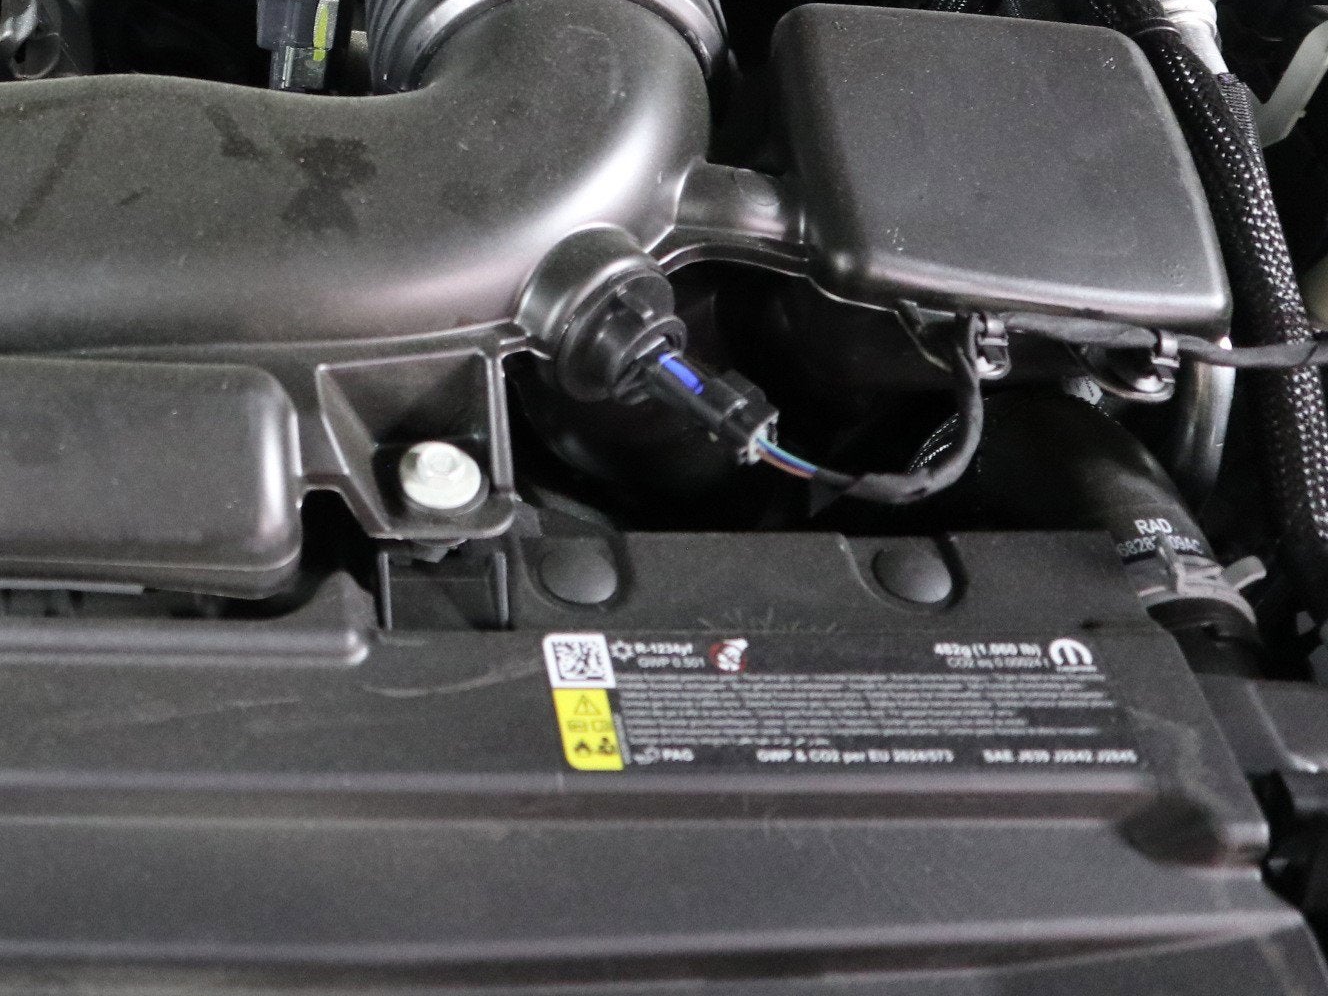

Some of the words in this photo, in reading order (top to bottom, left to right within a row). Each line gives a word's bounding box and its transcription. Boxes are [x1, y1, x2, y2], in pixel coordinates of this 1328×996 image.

[1134, 518, 1172, 535] RAD
[634, 643, 693, 657] R-1234yf
[662, 748, 695, 762] PAG
